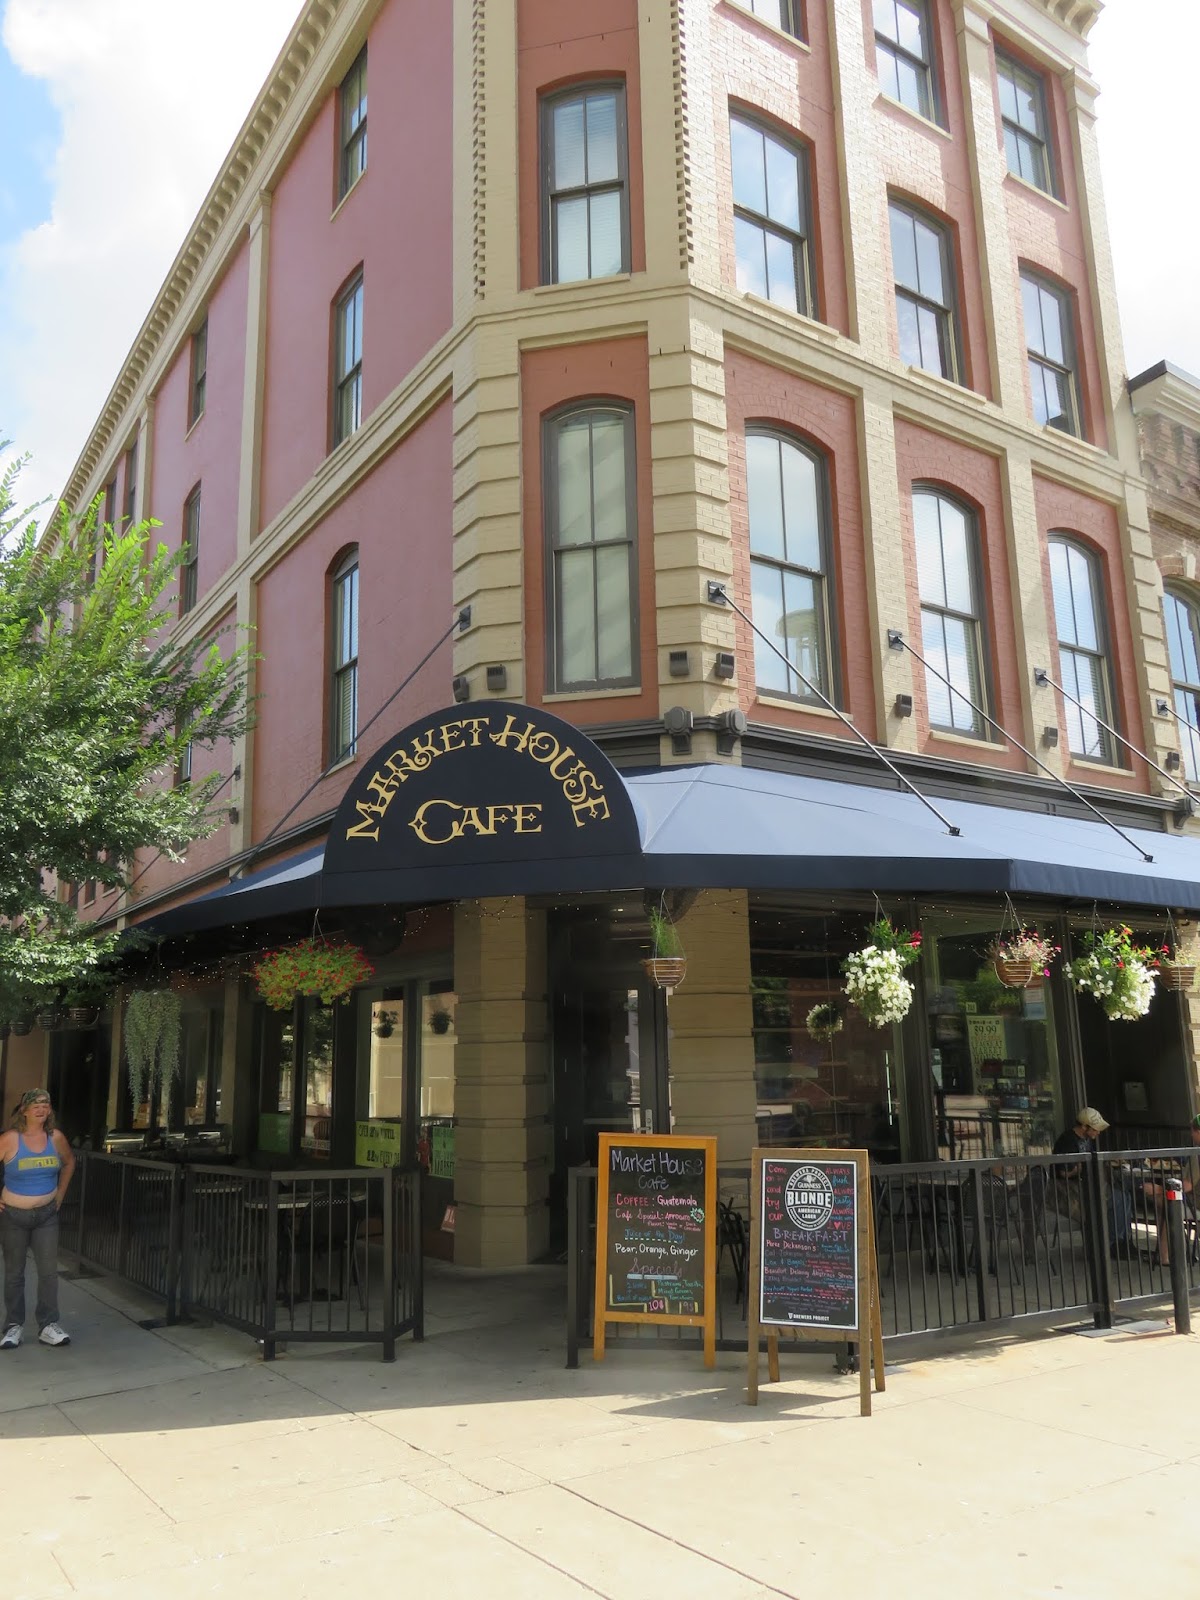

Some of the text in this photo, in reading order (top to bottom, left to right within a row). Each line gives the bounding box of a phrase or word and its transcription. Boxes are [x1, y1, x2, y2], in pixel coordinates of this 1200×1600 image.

[346, 714, 610, 842] MARKET HOUSE
[408, 799, 542, 844] CAFE
[612, 1149, 656, 1172] Market
[657, 1194, 698, 1206] Guatemala
[766, 1198, 780, 1210] try
[786, 1191, 831, 1208] BLONDE
[615, 1243, 699, 1261] Pear, Orange, Ginger
